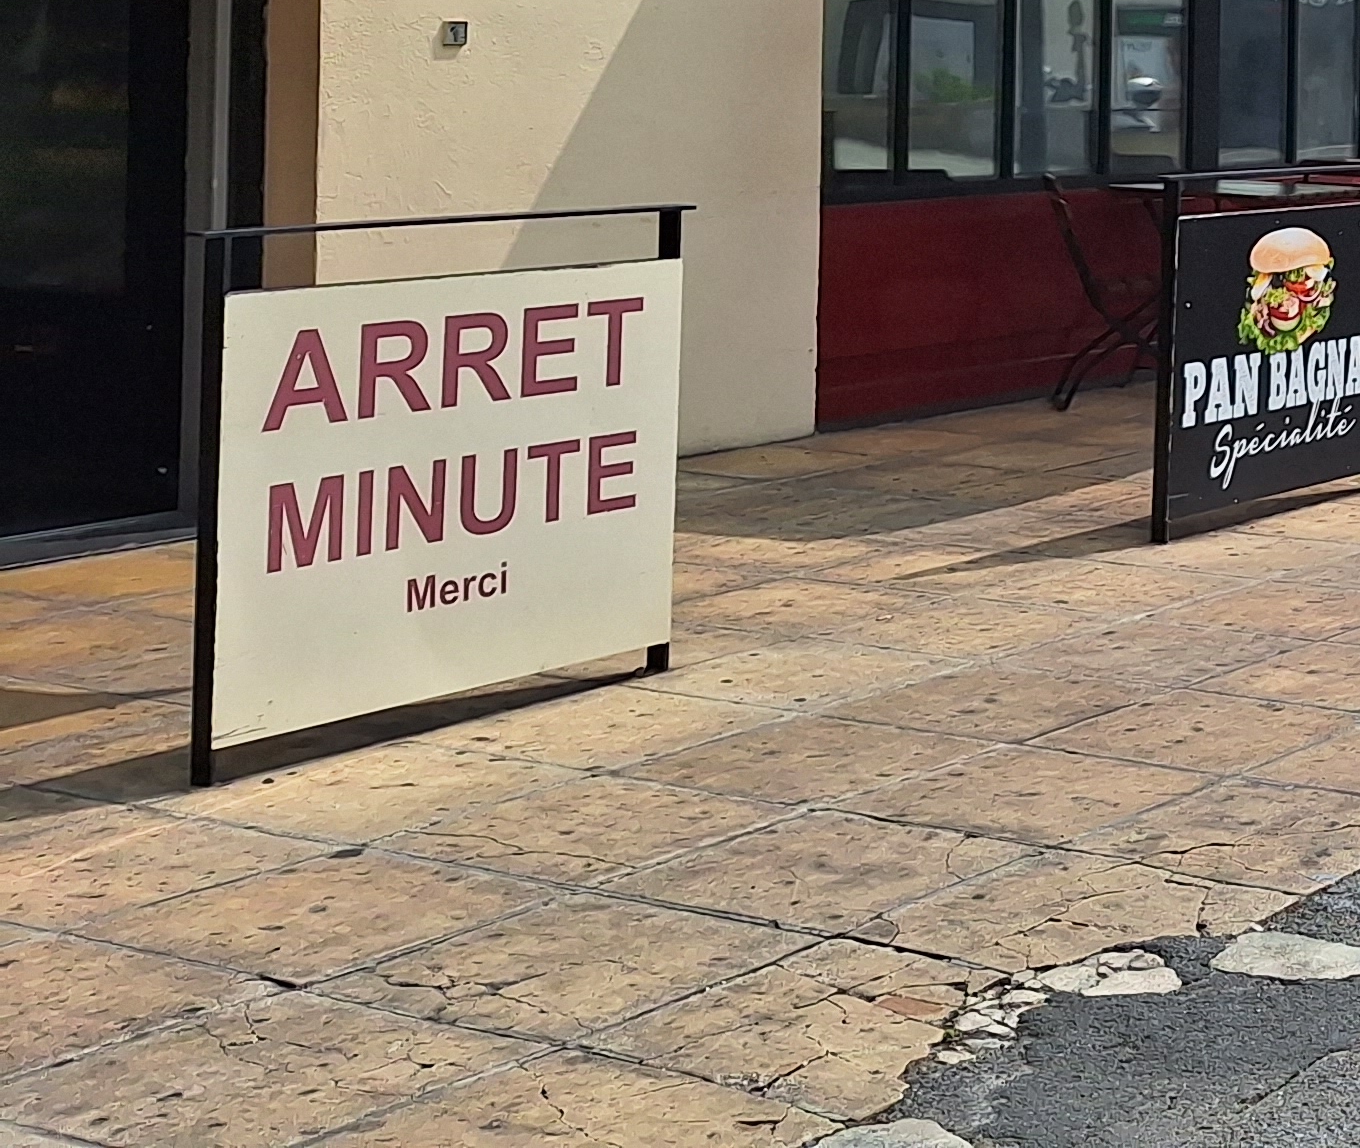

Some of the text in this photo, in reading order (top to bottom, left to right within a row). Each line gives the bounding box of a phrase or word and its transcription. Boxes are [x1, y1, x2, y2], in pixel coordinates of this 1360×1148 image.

[262, 297, 645, 433] ARRET
[1181, 352, 1262, 429] PAN
[1209, 399, 1356, 491] Spécialité
[266, 430, 638, 575] MINUTE
[406, 562, 509, 613] Merci
